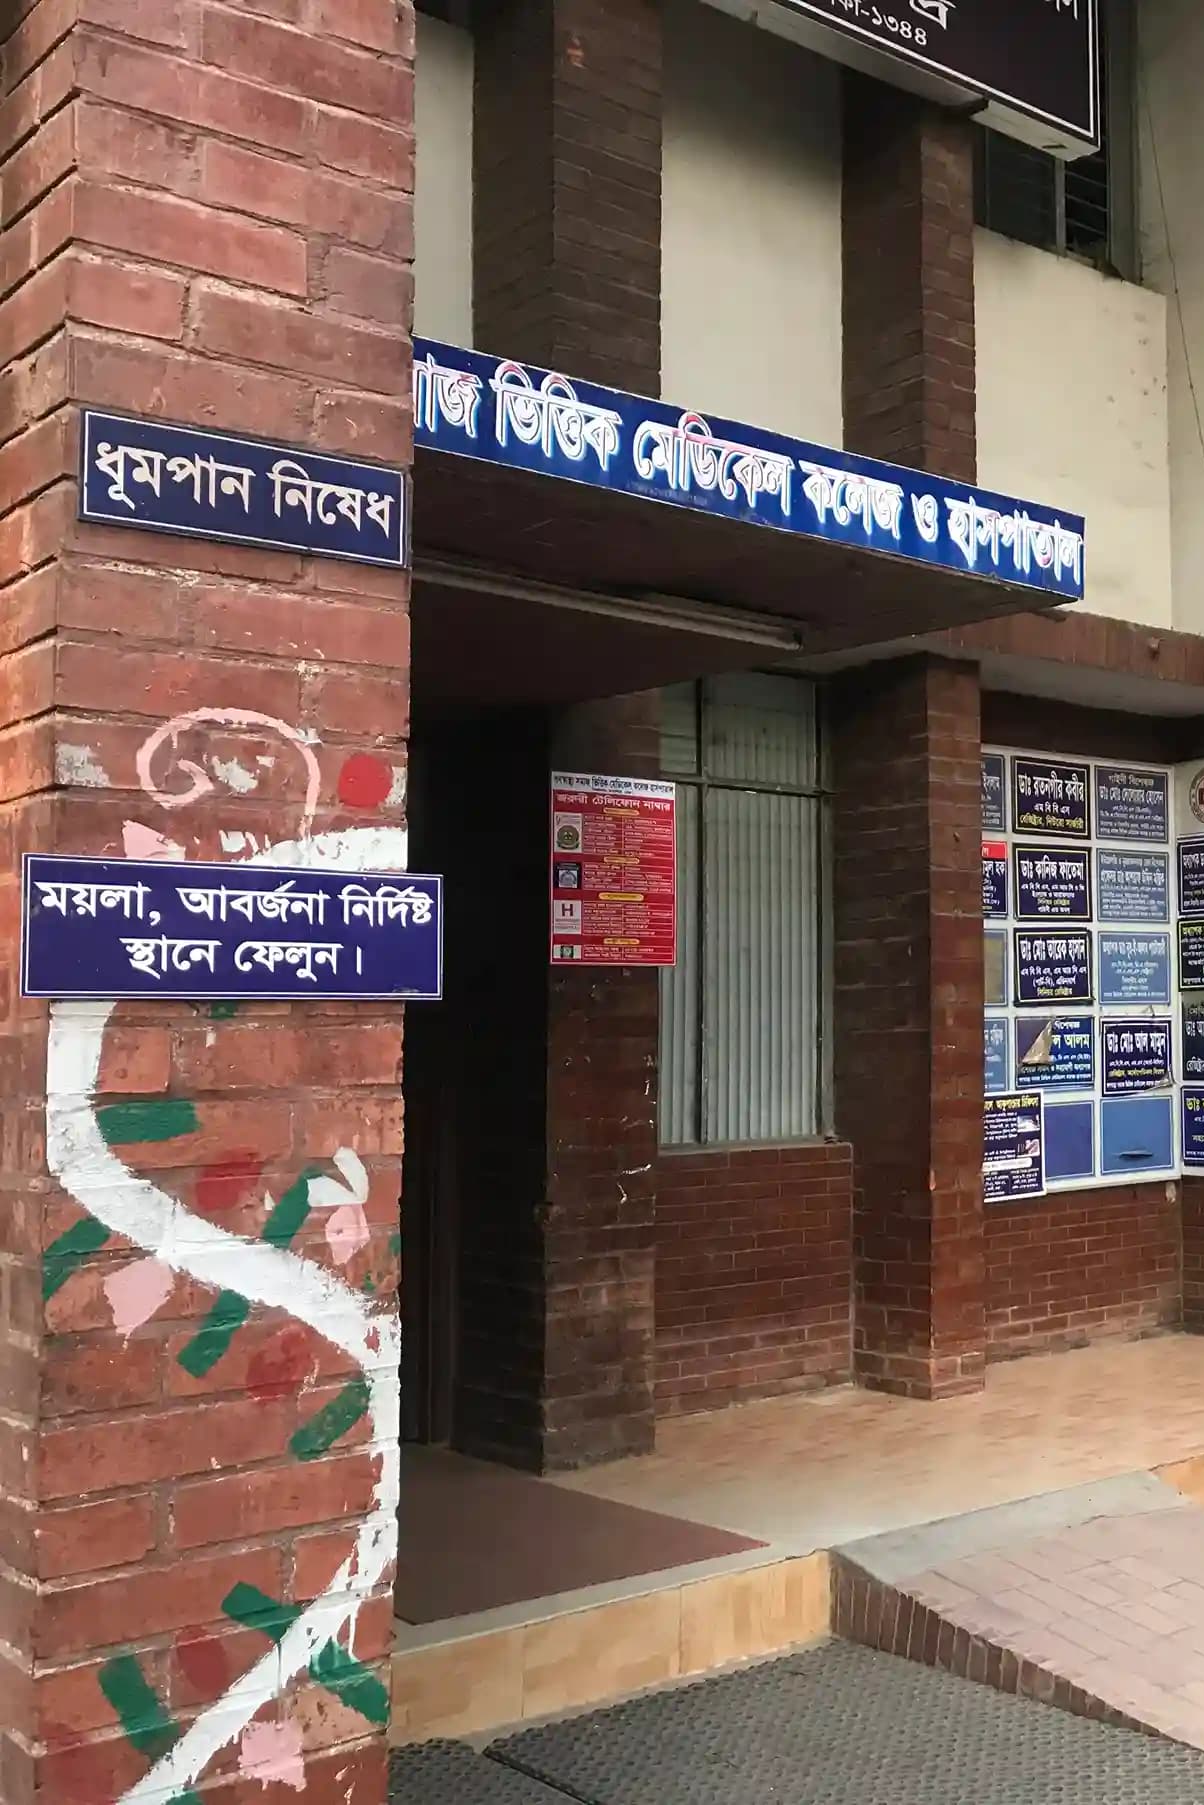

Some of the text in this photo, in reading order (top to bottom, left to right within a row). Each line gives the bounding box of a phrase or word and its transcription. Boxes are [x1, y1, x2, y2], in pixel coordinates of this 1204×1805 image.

[831, 0, 927, 46] কা-১৩৪৪
[95, 442, 395, 538] ধূমপান নিষেধ
[489, 361, 1084, 585] ভিত্তিক মেডিকেল কলেজ ও হাসপাতাল
[1020, 858, 1033, 879] ডাঃ
[35, 880, 434, 927] ময়লা, আবর্জনা নির্দিষ্ট
[561, 903, 573, 916] H
[120, 935, 222, 980] স্থানে
[1063, 1032, 1090, 1049] আলম
[1106, 1032, 1118, 1053] ডাঃ
[1120, 1030, 1133, 1053] মোঃ
[1185, 1096, 1200, 1111] ডাঃ
